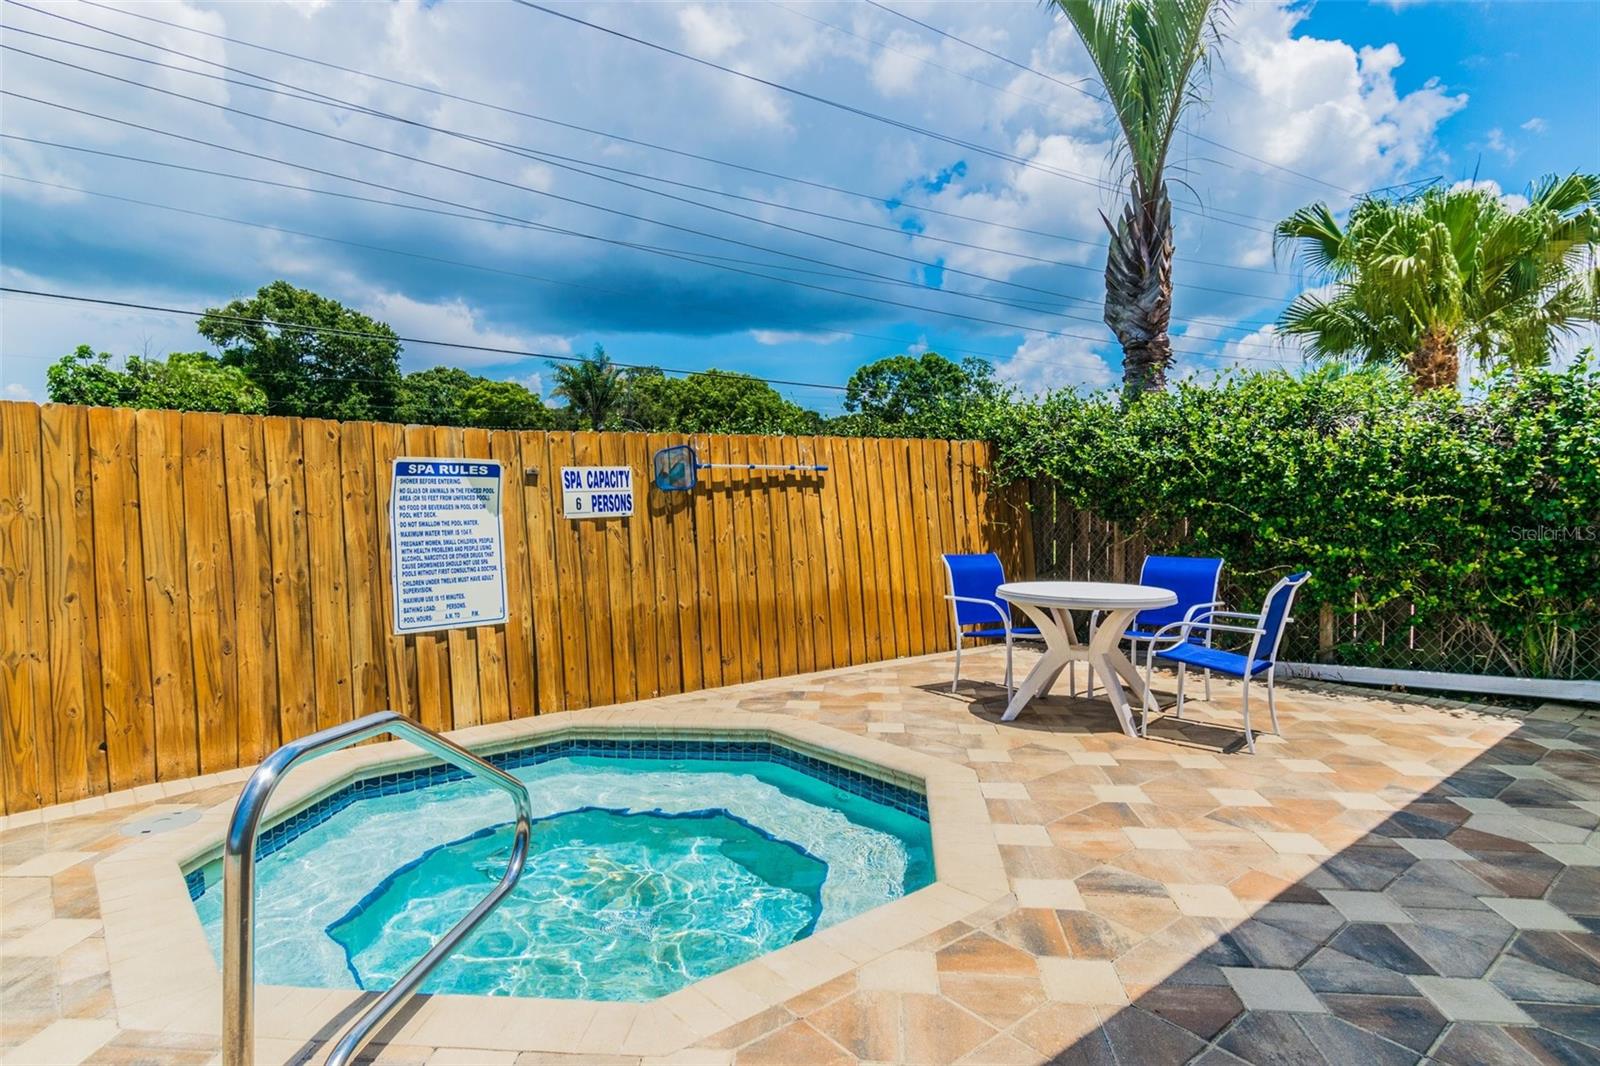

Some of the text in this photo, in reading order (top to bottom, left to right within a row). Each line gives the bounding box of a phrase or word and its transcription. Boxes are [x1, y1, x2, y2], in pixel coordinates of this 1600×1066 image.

[408, 464, 488, 474] SPA RULES
[564, 470, 630, 489] SPA CAPACITY
[576, 494, 632, 512] 6 PERSONS
